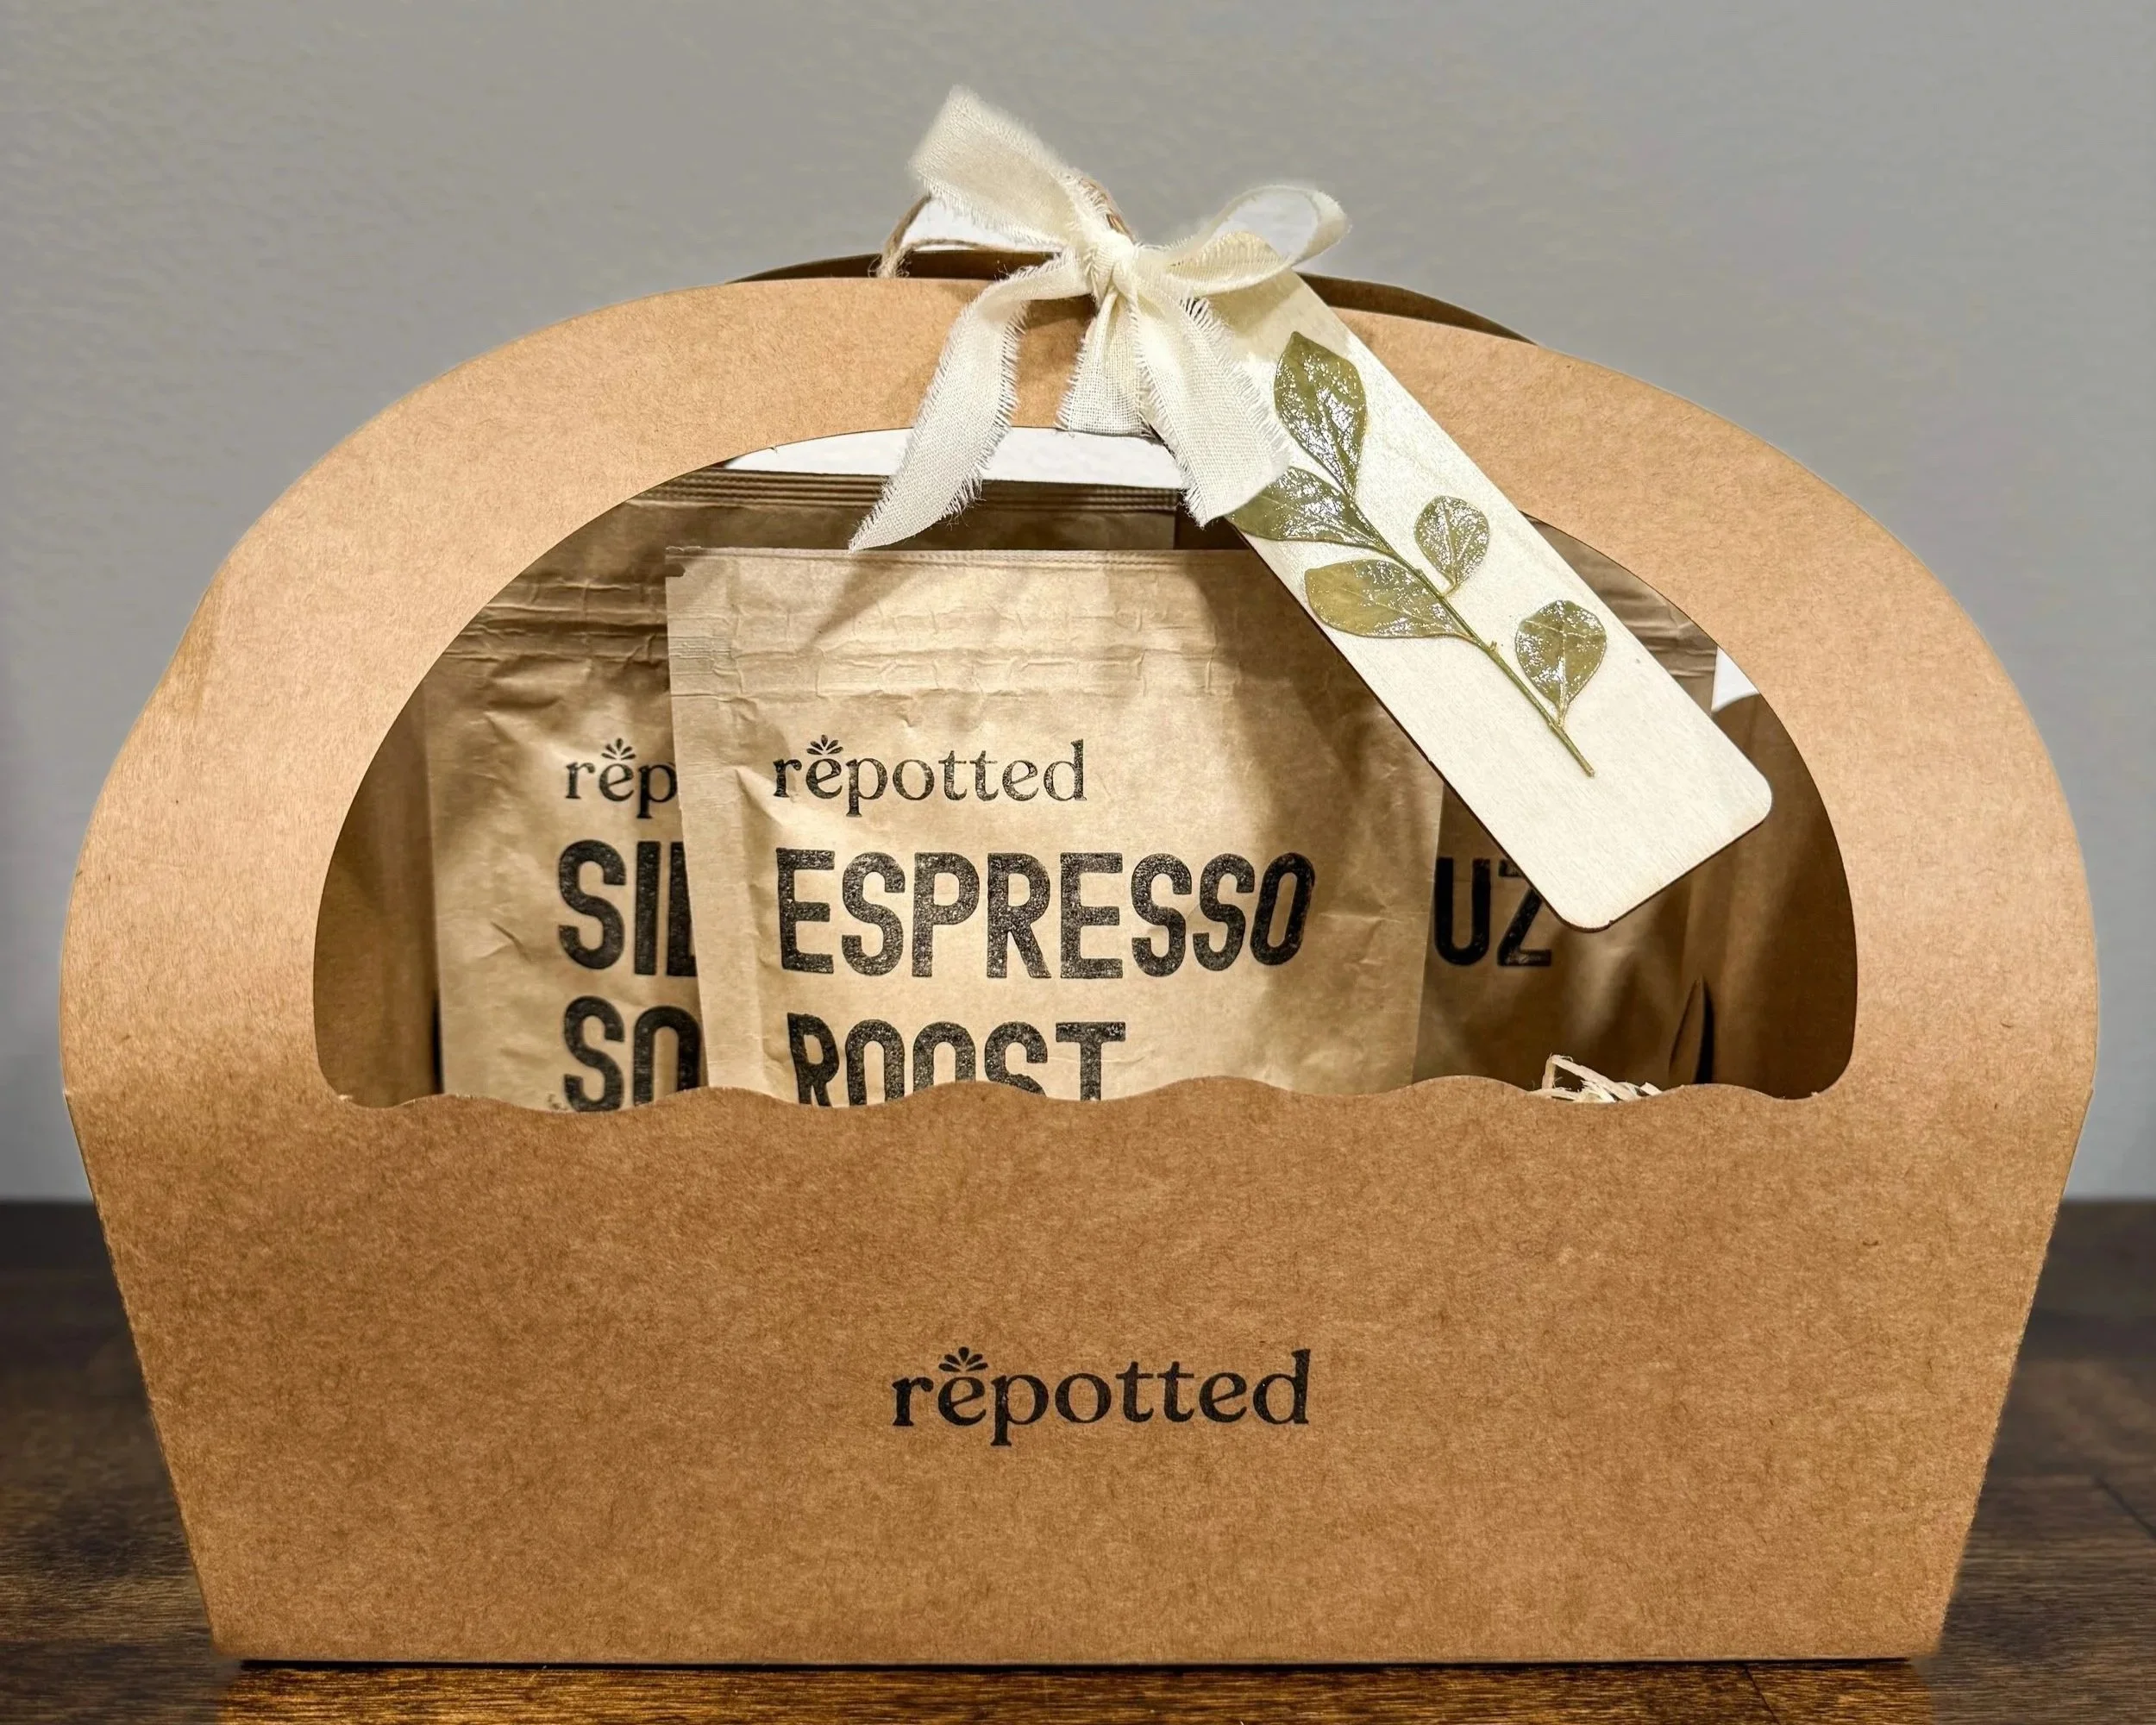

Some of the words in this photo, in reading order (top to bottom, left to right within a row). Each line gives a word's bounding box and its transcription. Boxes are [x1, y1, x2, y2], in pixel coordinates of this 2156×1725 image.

[773, 735, 1087, 818] repotted
[776, 847, 1315, 979] ESPRESSO
[892, 1346, 1311, 1446] repotted
